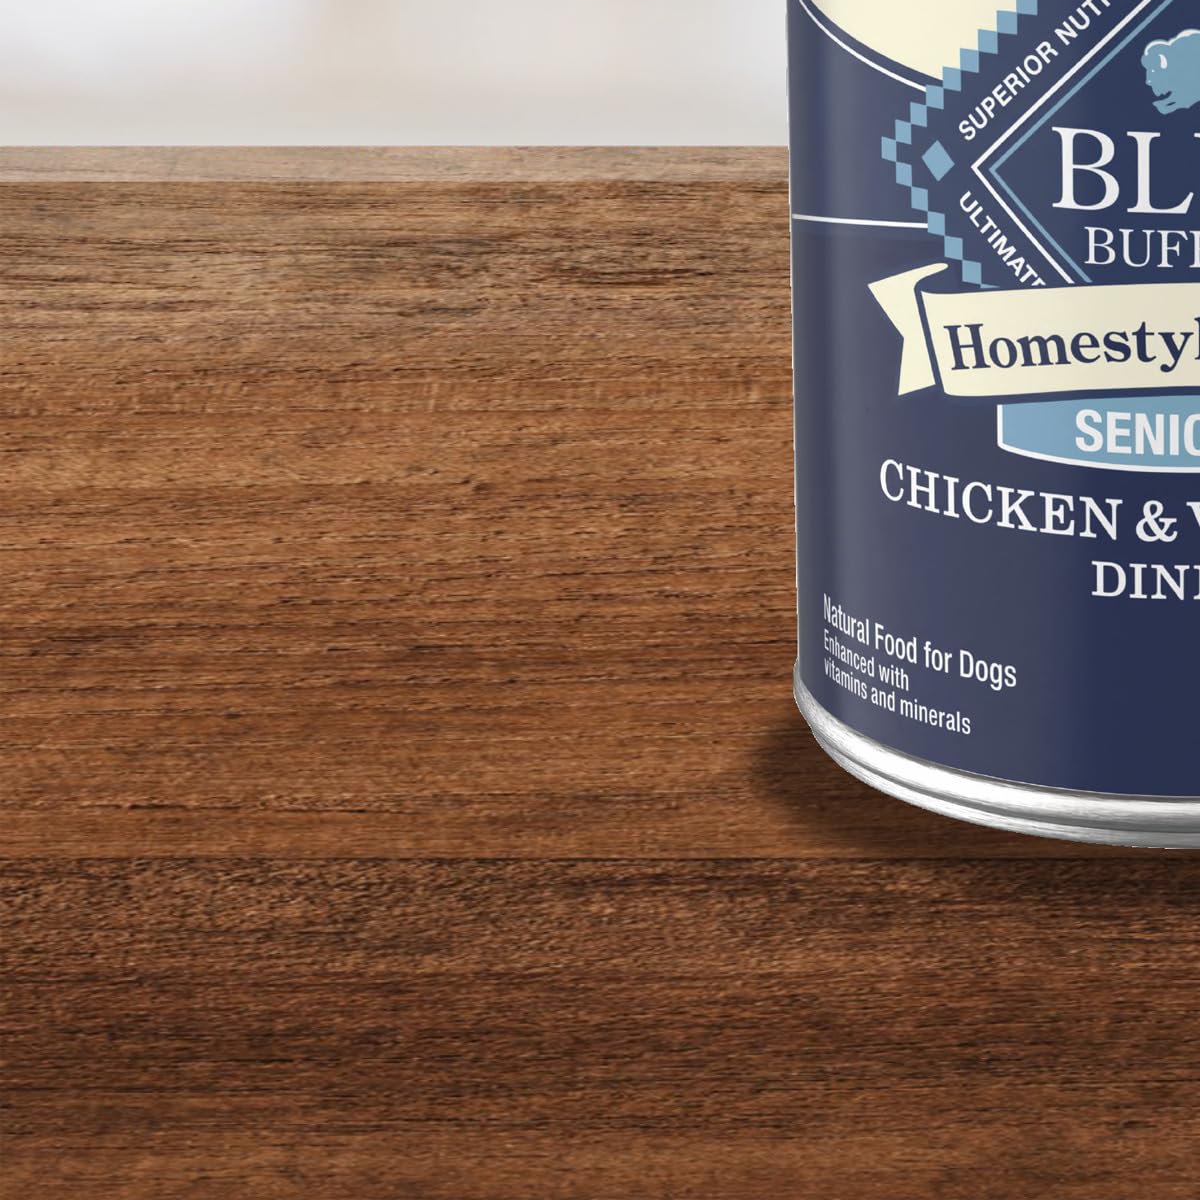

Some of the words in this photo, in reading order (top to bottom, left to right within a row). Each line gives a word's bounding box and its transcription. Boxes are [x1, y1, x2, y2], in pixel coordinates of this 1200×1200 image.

[958, 40, 1059, 142] SUPERIOR
[879, 458, 1123, 542] CHICKEN
[1134, 501, 1179, 543] &
[823, 592, 870, 646] Natural
[874, 622, 918, 664] Food
[923, 640, 953, 673] for
[959, 649, 1017, 691] Dogs
[823, 628, 875, 678] Enhanced
[878, 663, 910, 691] with
[824, 657, 868, 700] vitamins
[871, 684, 896, 712] and
[900, 697, 971, 735] minerals
